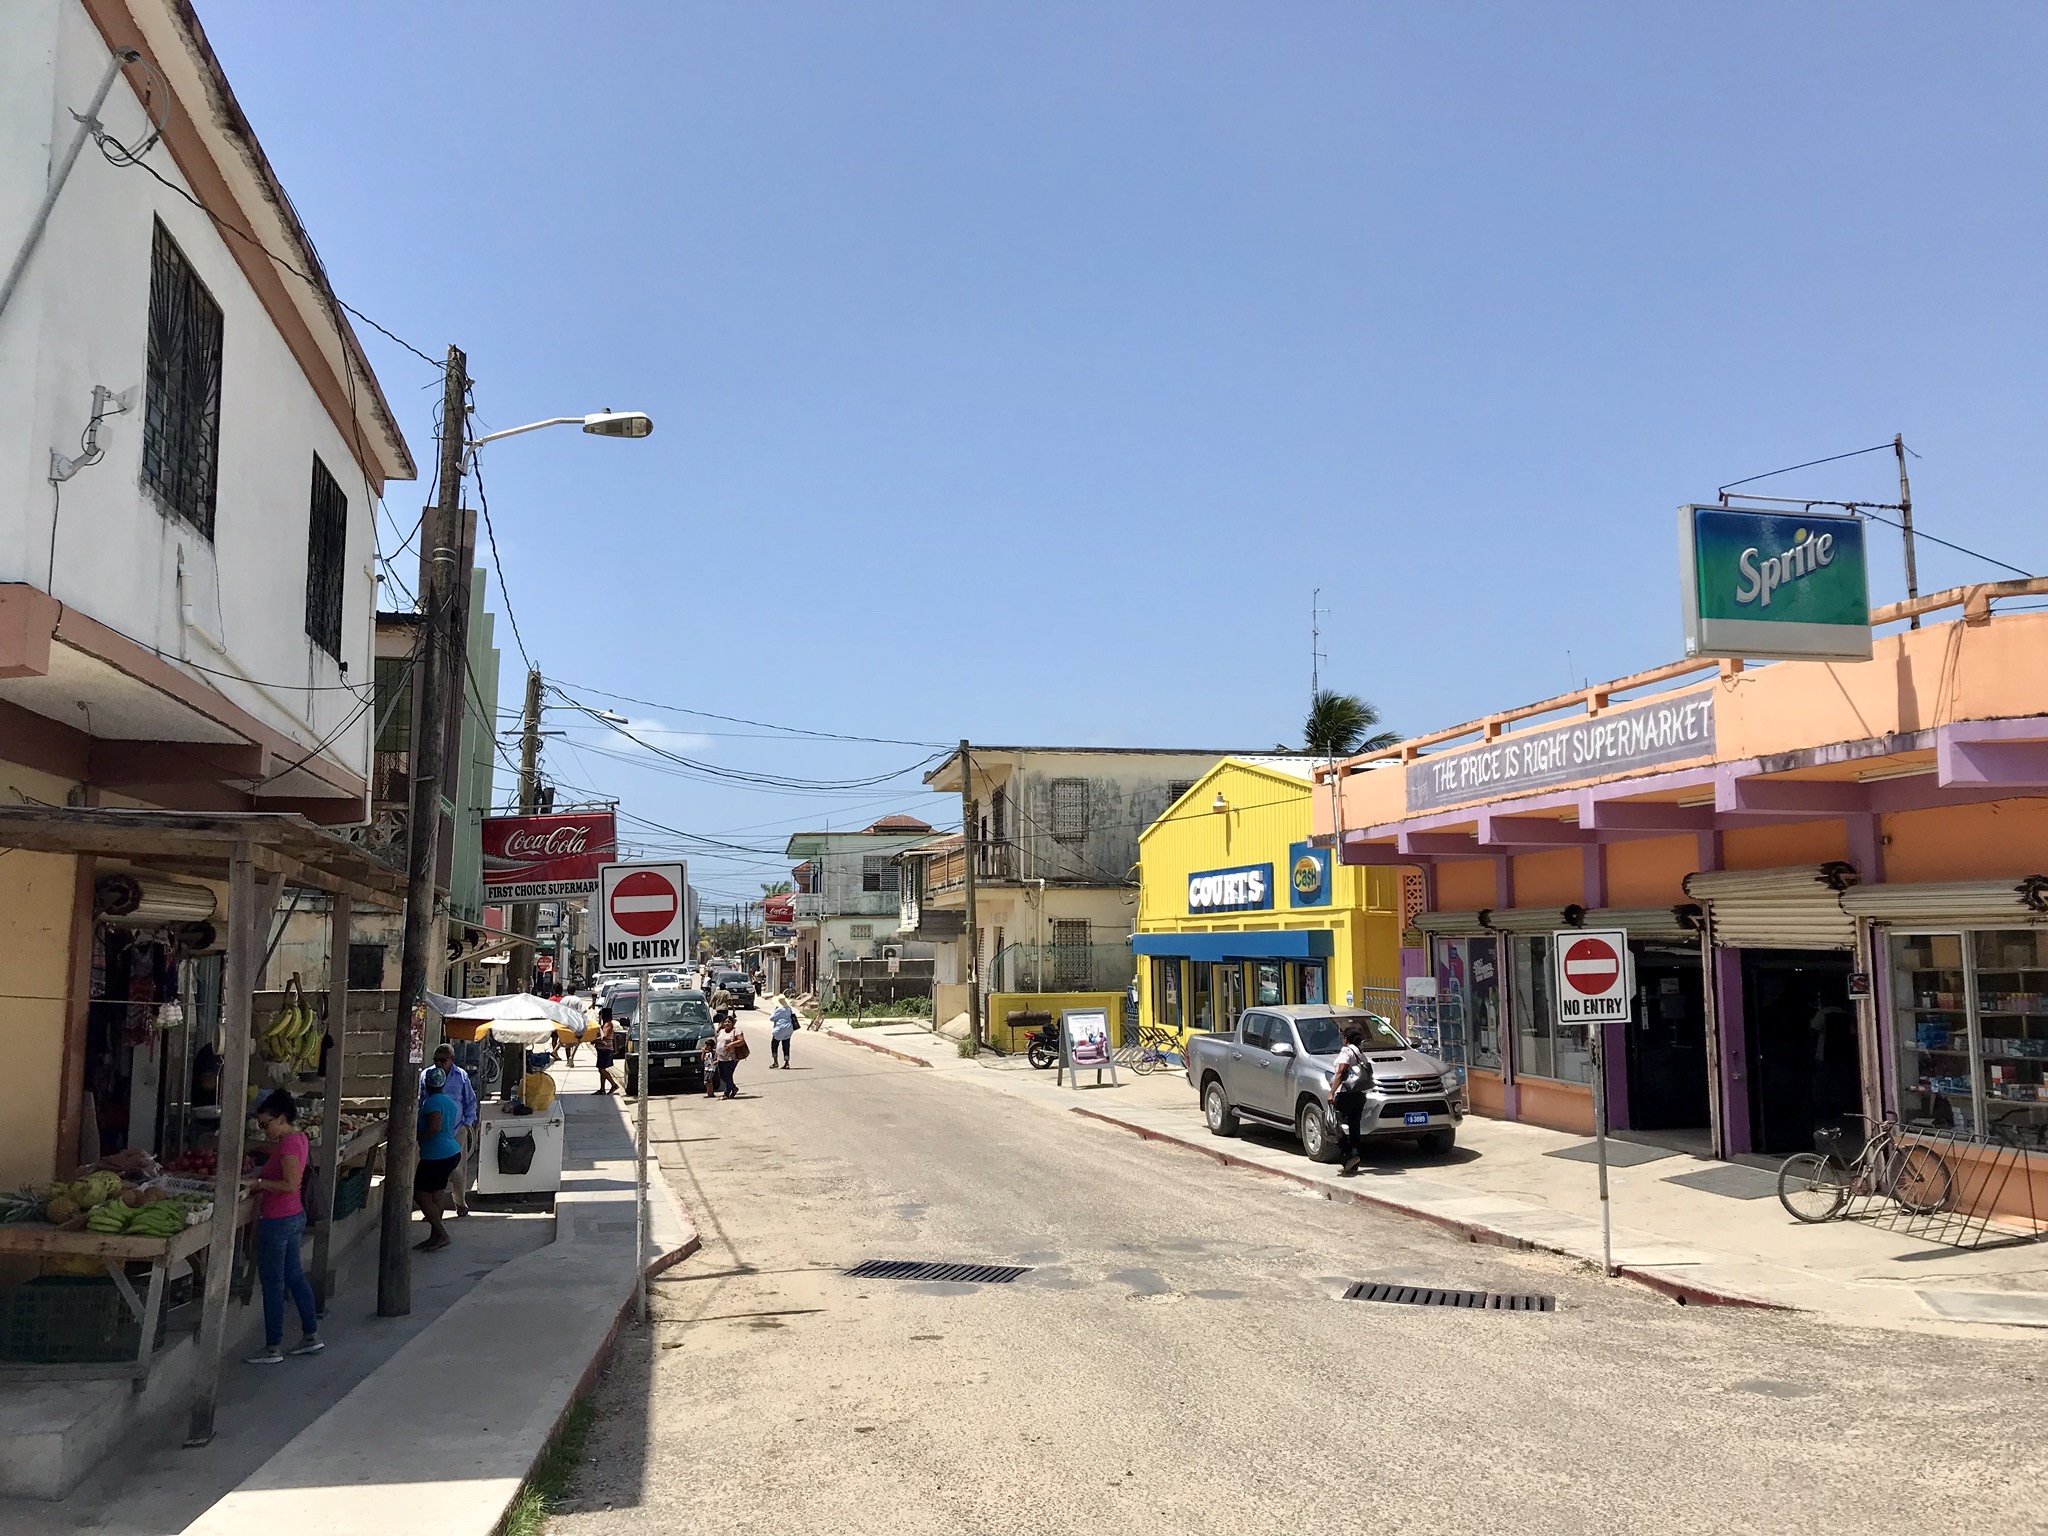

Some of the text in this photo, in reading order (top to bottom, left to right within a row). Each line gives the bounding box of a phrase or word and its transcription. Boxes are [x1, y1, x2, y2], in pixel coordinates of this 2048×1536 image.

[1736, 528, 1835, 606] Sprite
[1432, 696, 1713, 793] THE PRICE IS RIGHT SUPERMARKET
[504, 826, 592, 857] Coca-Cola
[488, 886, 513, 899] FIRST
[514, 883, 547, 897] CHOICE
[1189, 870, 1264, 907] COURTS
[608, 939, 680, 960] NO ENTRY
[1564, 998, 1623, 1015] NO ENTRY
